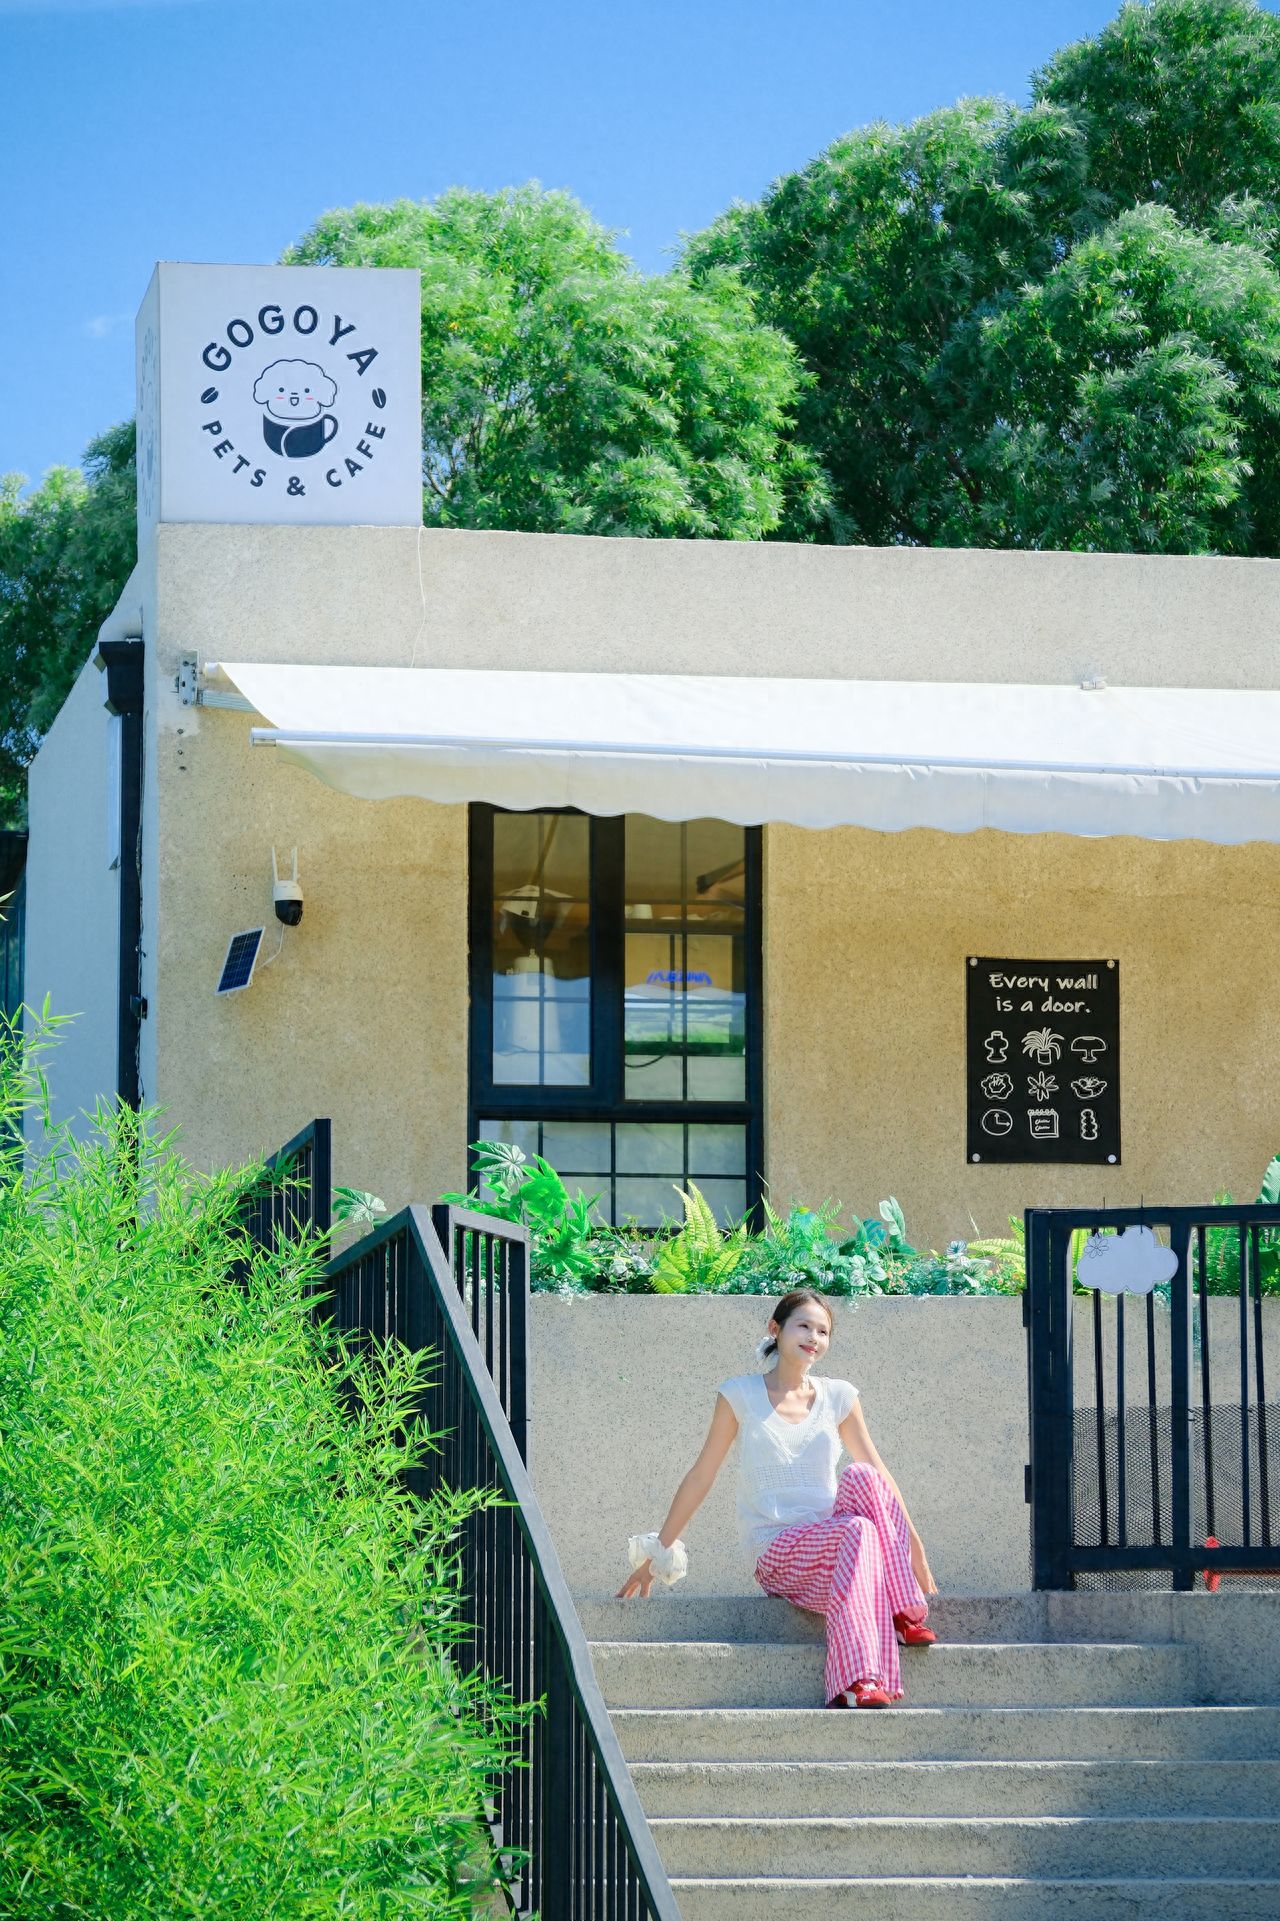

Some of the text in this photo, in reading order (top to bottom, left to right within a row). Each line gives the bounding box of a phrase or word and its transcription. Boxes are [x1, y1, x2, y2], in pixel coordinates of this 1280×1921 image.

[203, 305, 379, 376] GOGOYA
[202, 421, 267, 488] PETS
[287, 476, 306, 496] &
[326, 422, 386, 488] CAFE
[989, 973, 1098, 992] Every wall
[996, 996, 1091, 1013] is a door.
